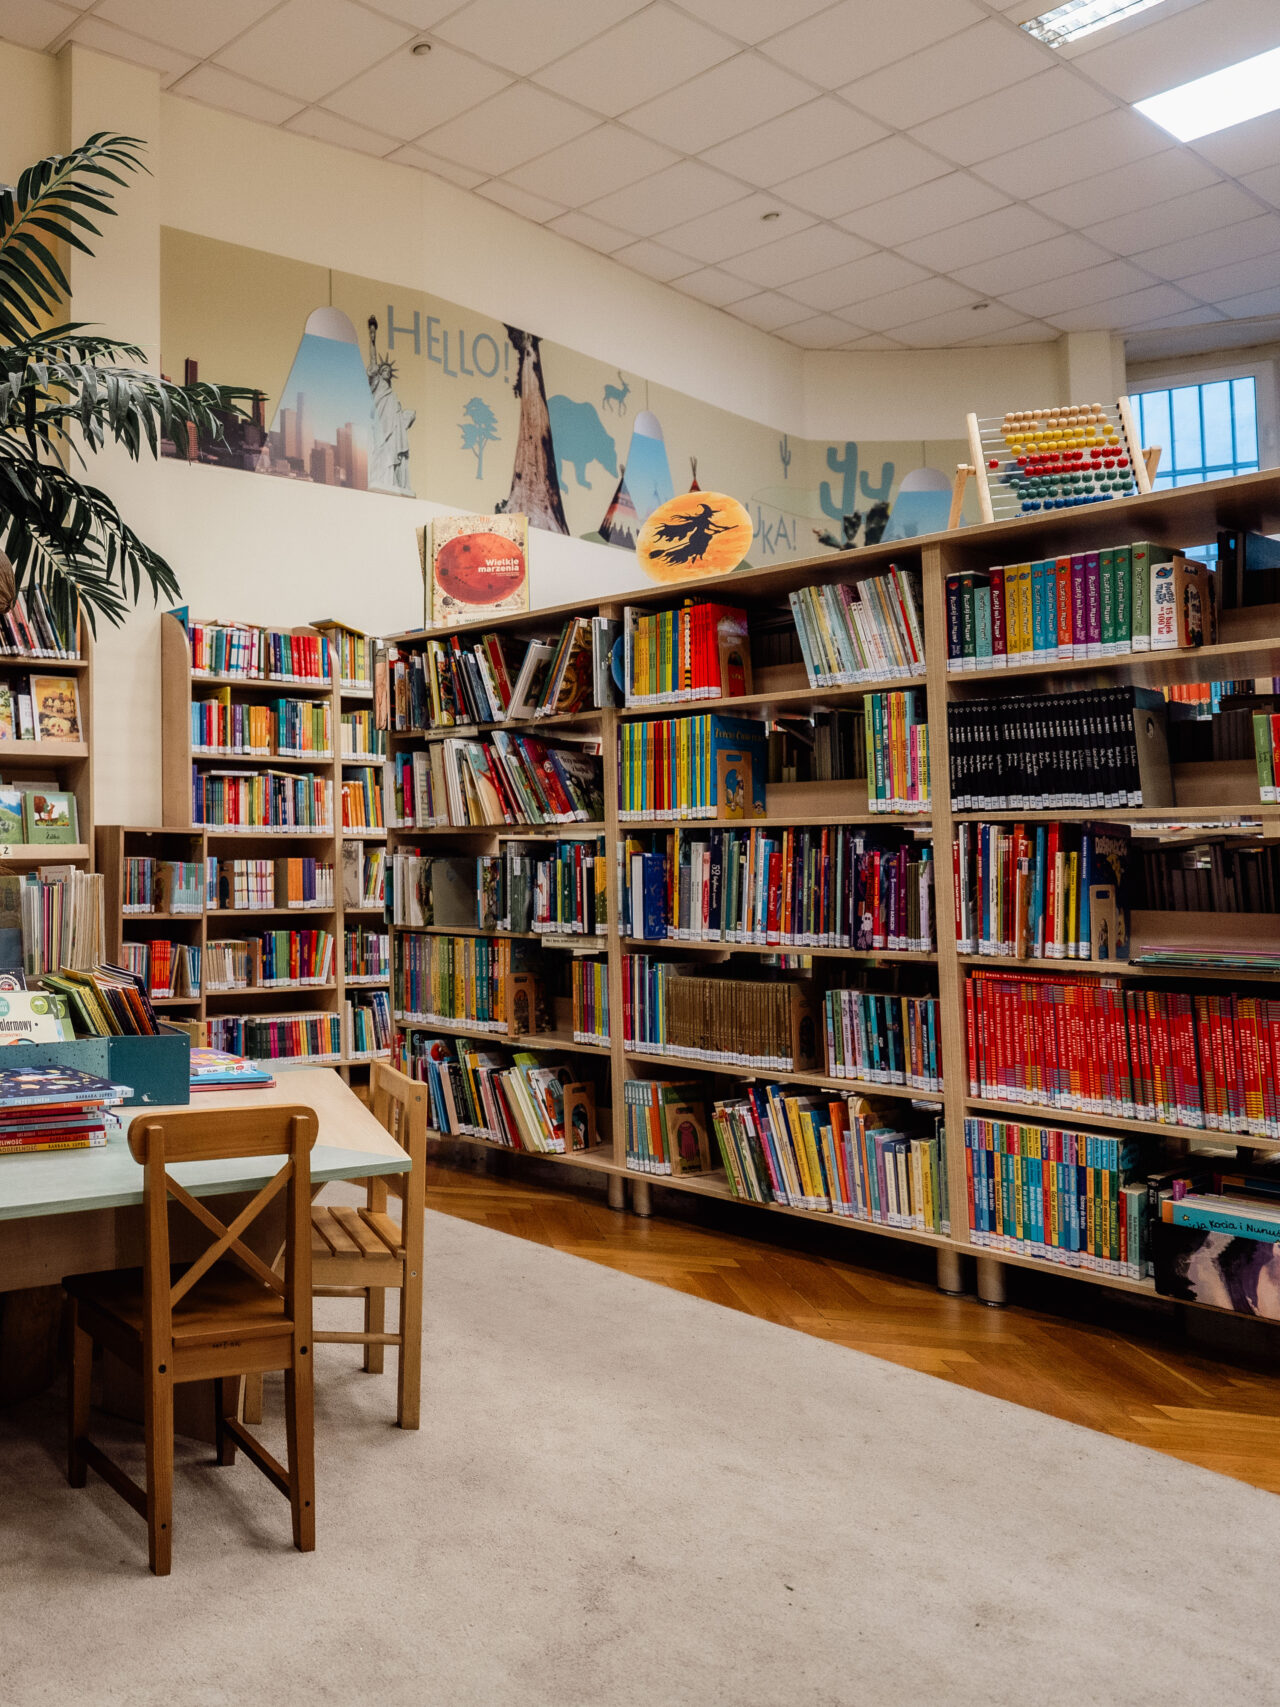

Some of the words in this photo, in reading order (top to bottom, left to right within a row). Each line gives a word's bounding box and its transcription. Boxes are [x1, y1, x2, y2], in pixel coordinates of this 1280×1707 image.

[387, 304, 511, 384] HELLO!
[485, 558, 519, 566] Wielkie
[478, 565, 519, 573] marzenia
[1165, 616, 1173, 635] bajek
[0, 1018, 32, 1032] alarmowy
[1209, 1220, 1237, 1231] Kocia
